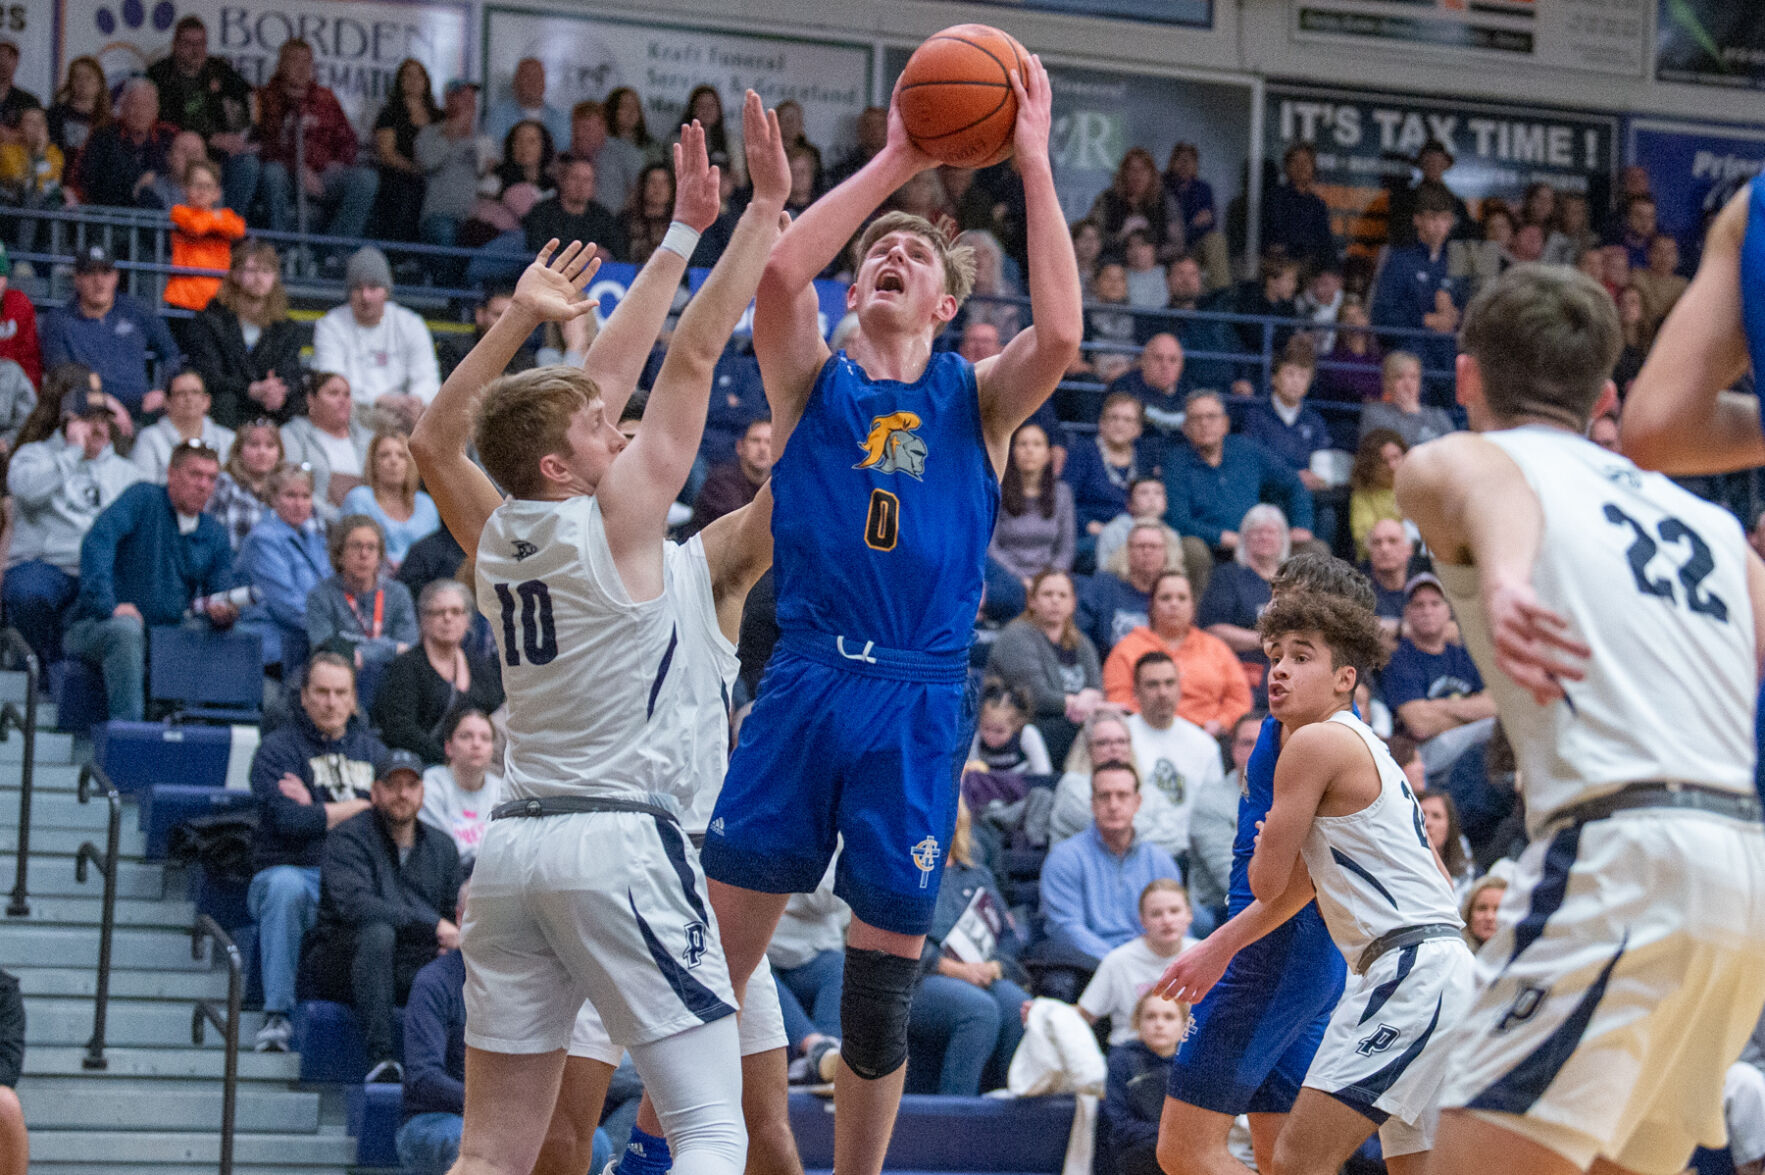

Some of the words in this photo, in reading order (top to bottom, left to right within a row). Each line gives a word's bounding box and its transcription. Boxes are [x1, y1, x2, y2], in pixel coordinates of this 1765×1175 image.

[219, 7, 434, 62] BORDEN
[710, 47, 786, 71] Funeral
[1280, 101, 1361, 147] IT'S
[1371, 109, 1458, 154] TAX
[1470, 119, 1574, 167] TIME
[1585, 129, 1599, 169] !
[864, 488, 900, 552] 0
[1603, 503, 1729, 624] 22
[494, 579, 558, 666] 10
[1400, 780, 1431, 850] 2
[682, 920, 708, 969] P
[1355, 1023, 1401, 1057] P
